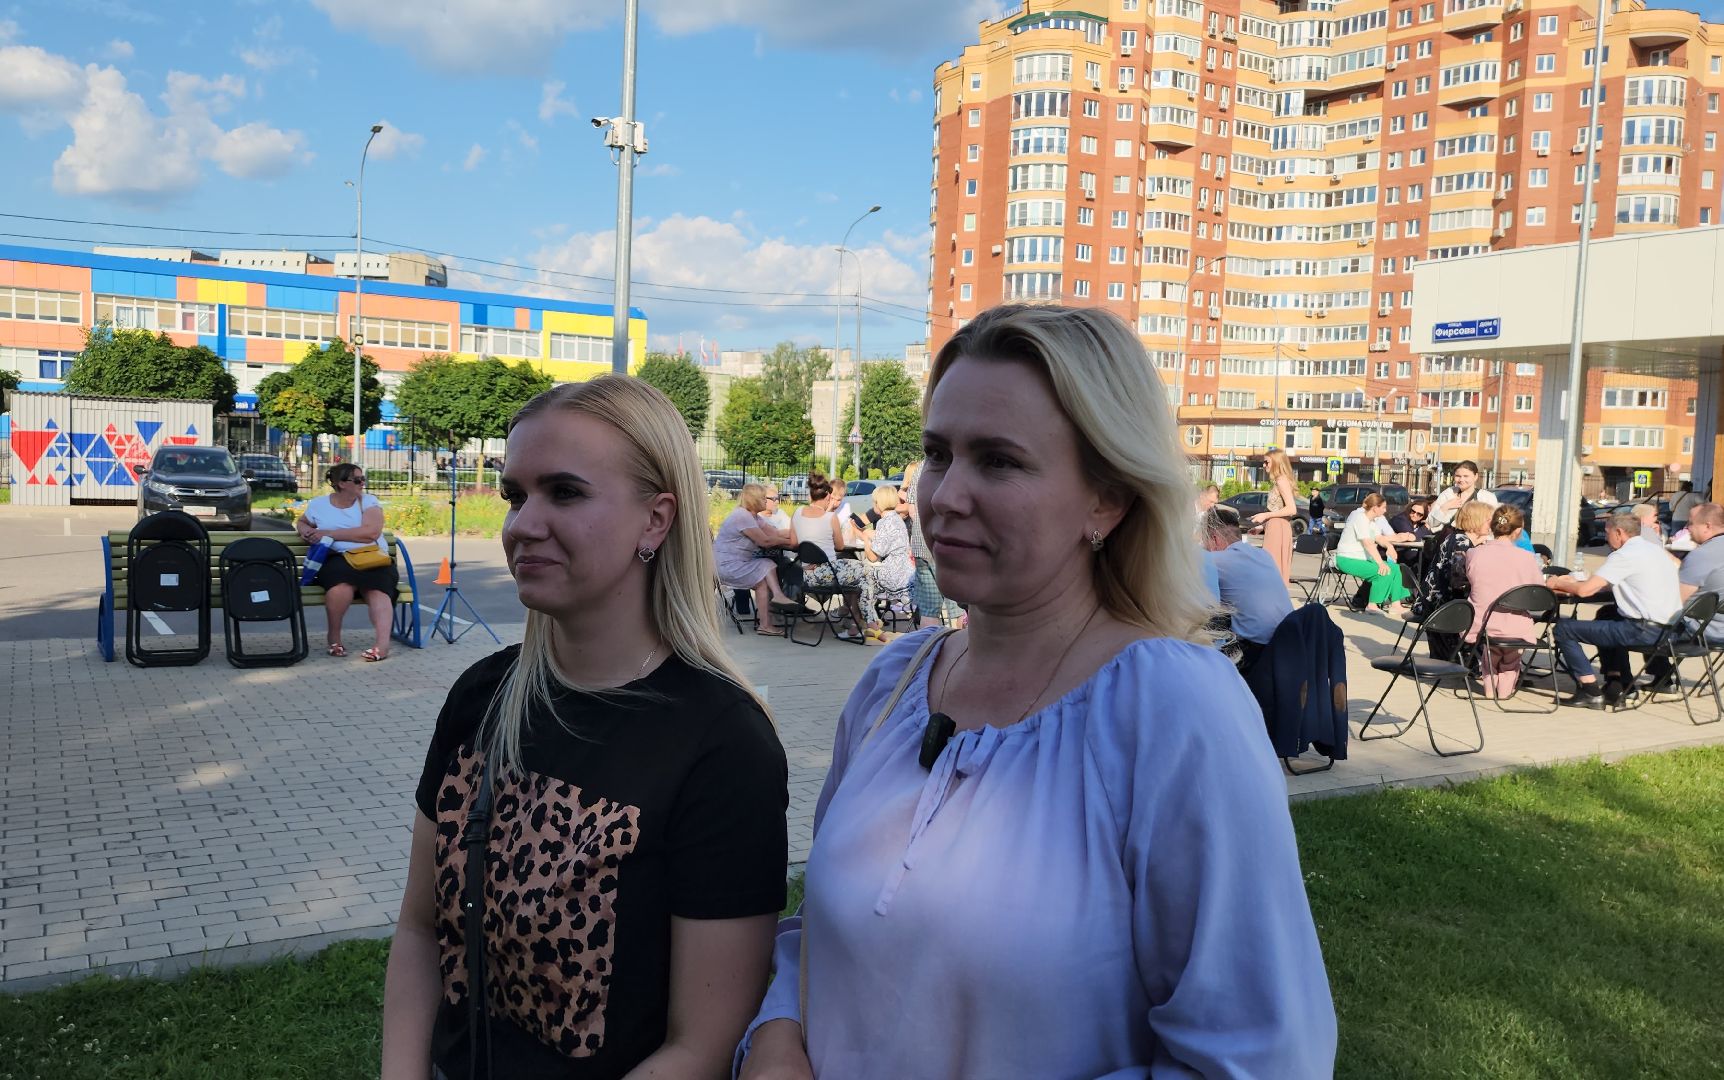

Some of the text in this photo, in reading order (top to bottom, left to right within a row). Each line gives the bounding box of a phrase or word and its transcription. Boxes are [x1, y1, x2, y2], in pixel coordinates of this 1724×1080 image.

[1435, 328, 1475, 337] Фирсова
[1260, 418, 1310, 427] СТУИЯ ЙОГИ
